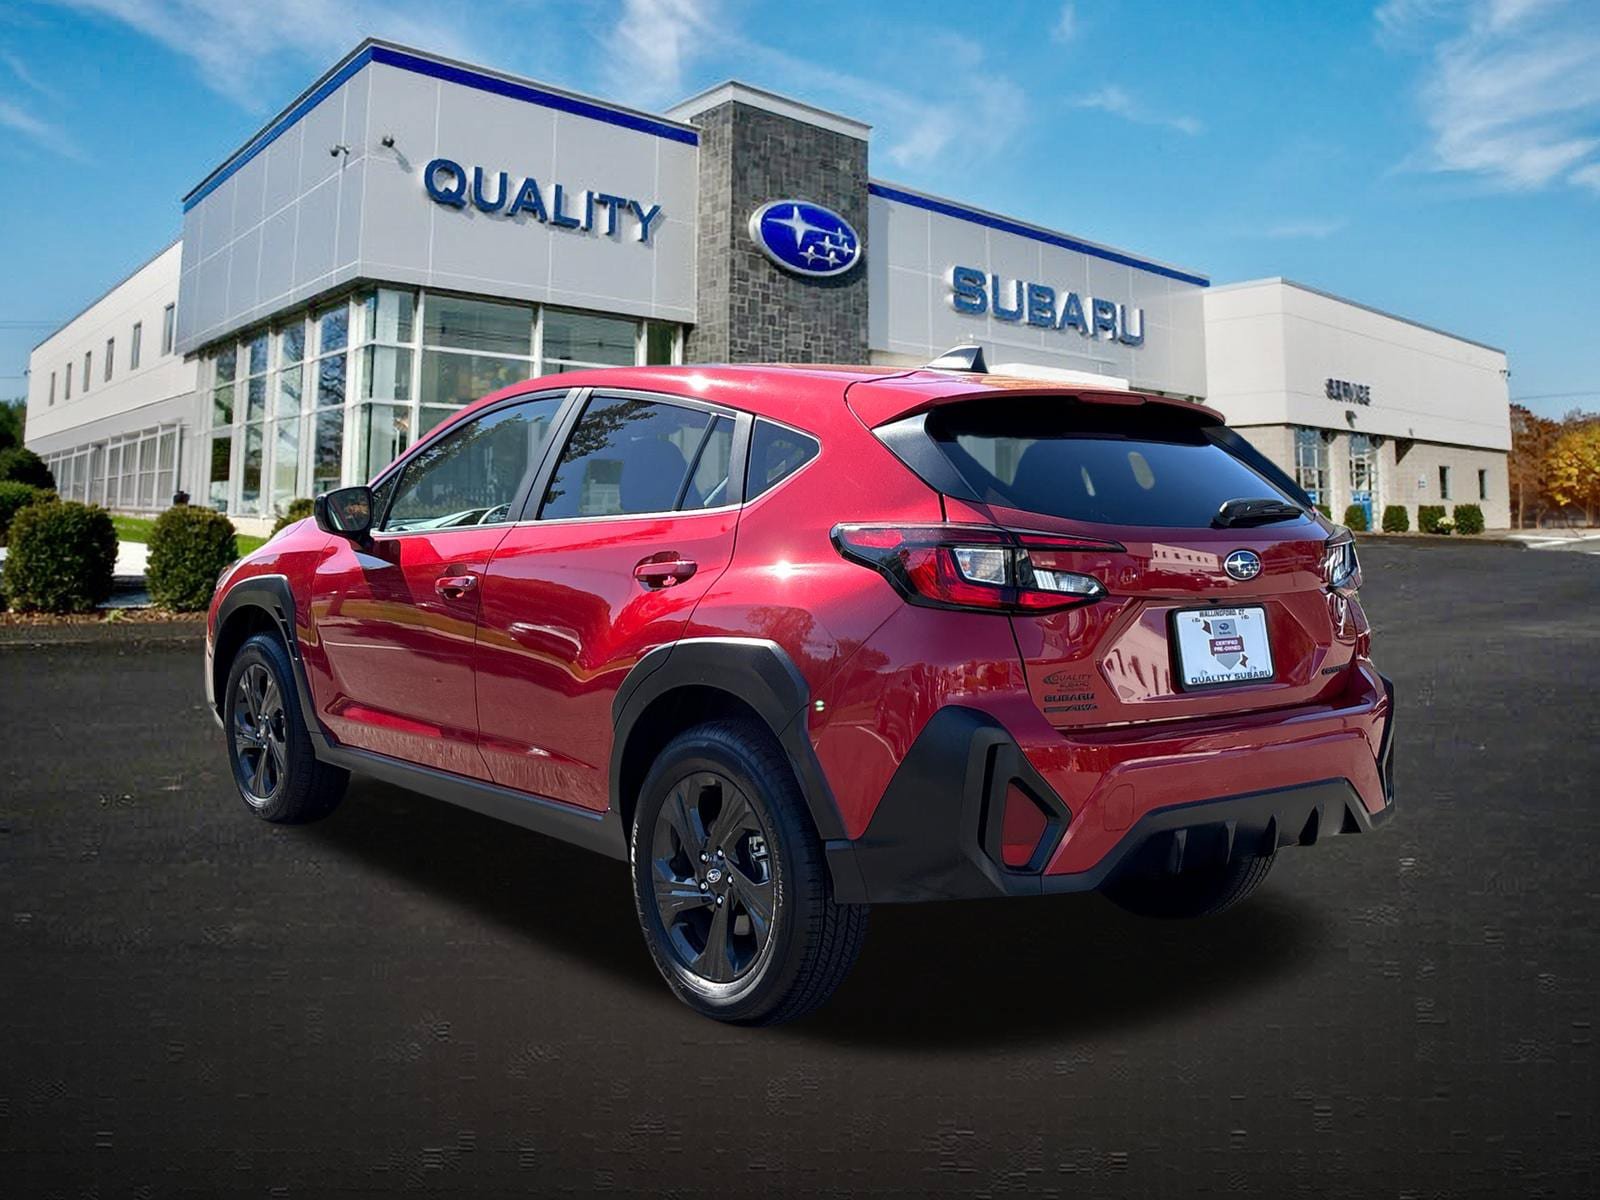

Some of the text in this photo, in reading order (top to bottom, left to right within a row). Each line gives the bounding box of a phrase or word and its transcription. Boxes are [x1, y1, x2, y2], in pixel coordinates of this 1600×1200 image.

[423, 158, 662, 242] QUALITY
[949, 265, 1145, 346] SUBARU
[1325, 378, 1370, 406] SERVICE
[1191, 670, 1271, 684] QUALITY SUBARU
[1044, 692, 1096, 703] SUBARU
